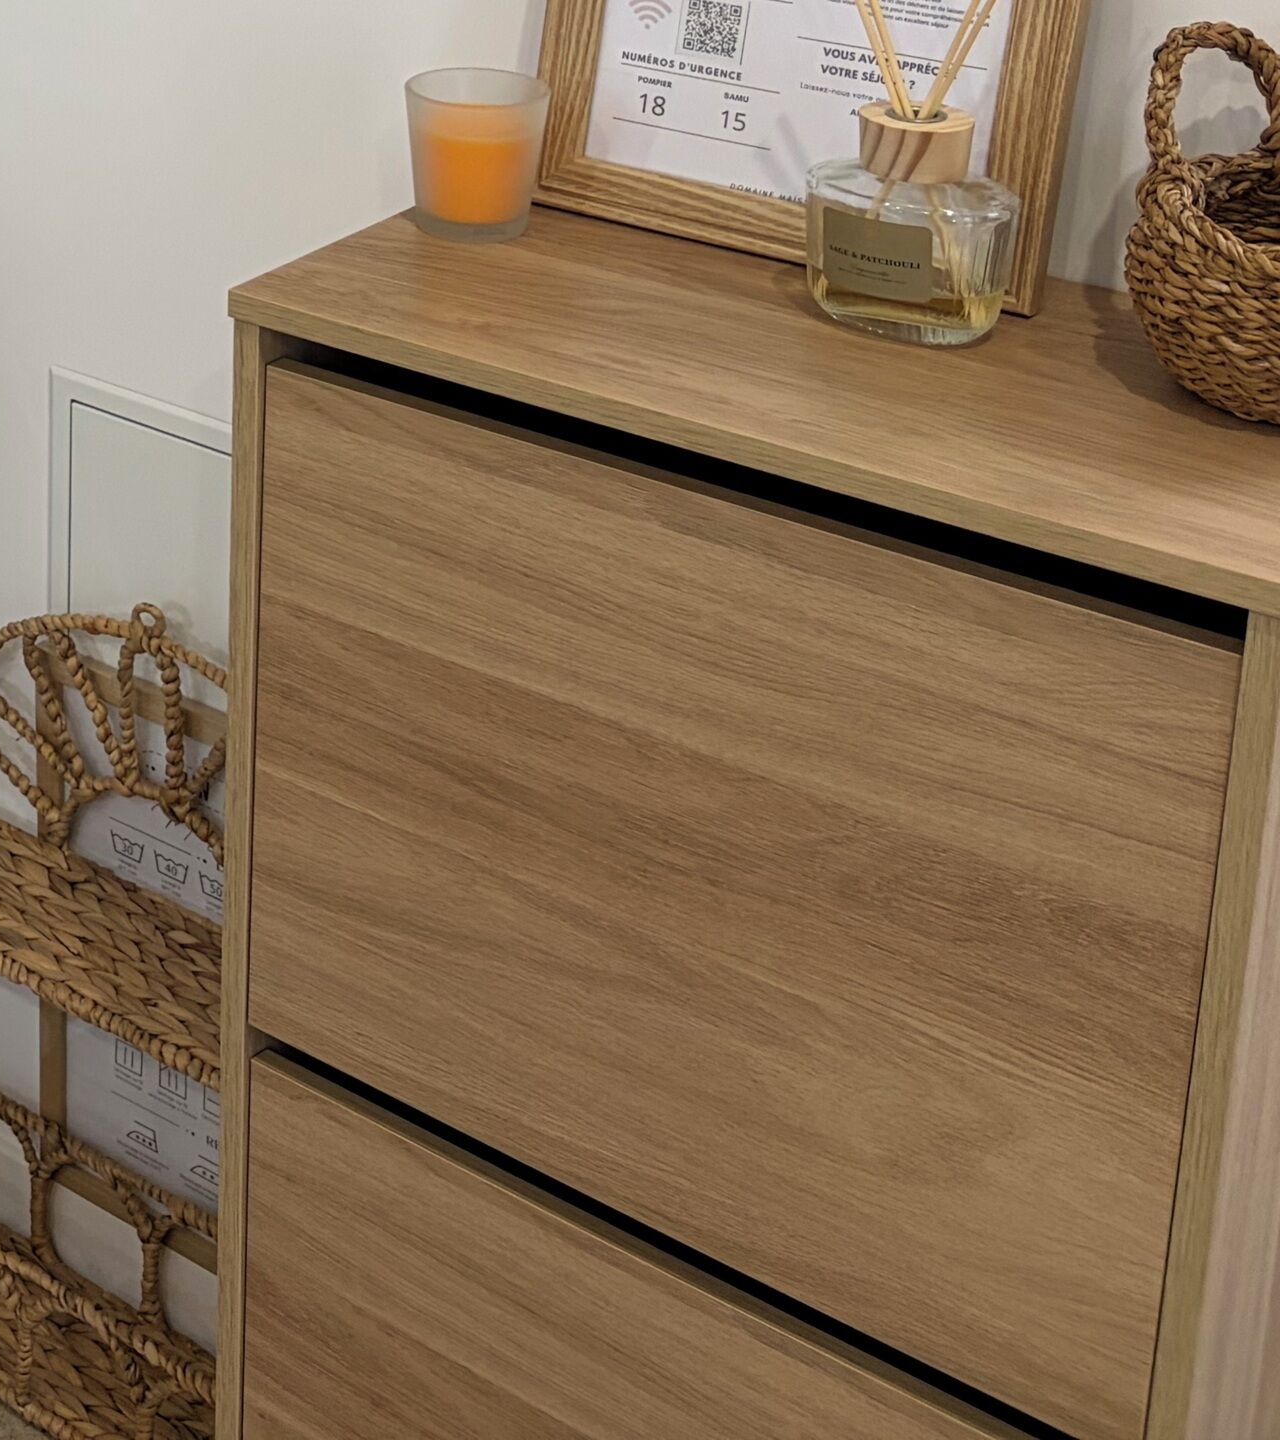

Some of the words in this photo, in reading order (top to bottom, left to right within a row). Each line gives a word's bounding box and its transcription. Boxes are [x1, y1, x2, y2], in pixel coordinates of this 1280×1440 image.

[823, 46, 856, 61] VOUS
[622, 51, 675, 69] NUMÉROS
[679, 63, 743, 81] D'URGENCE
[638, 76, 672, 88] POMPIER
[821, 64, 858, 80] VOTRE
[909, 80, 916, 90] ?
[724, 92, 750, 103] SAMU
[800, 82, 850, 98] Laissez-nous
[639, 93, 666, 117] 18
[721, 110, 747, 132] 15
[860, 253, 921, 271] PATCHOULI
[121, 842, 134, 856] 30
[164, 863, 178, 877] 40
[209, 883, 223, 897] 50
